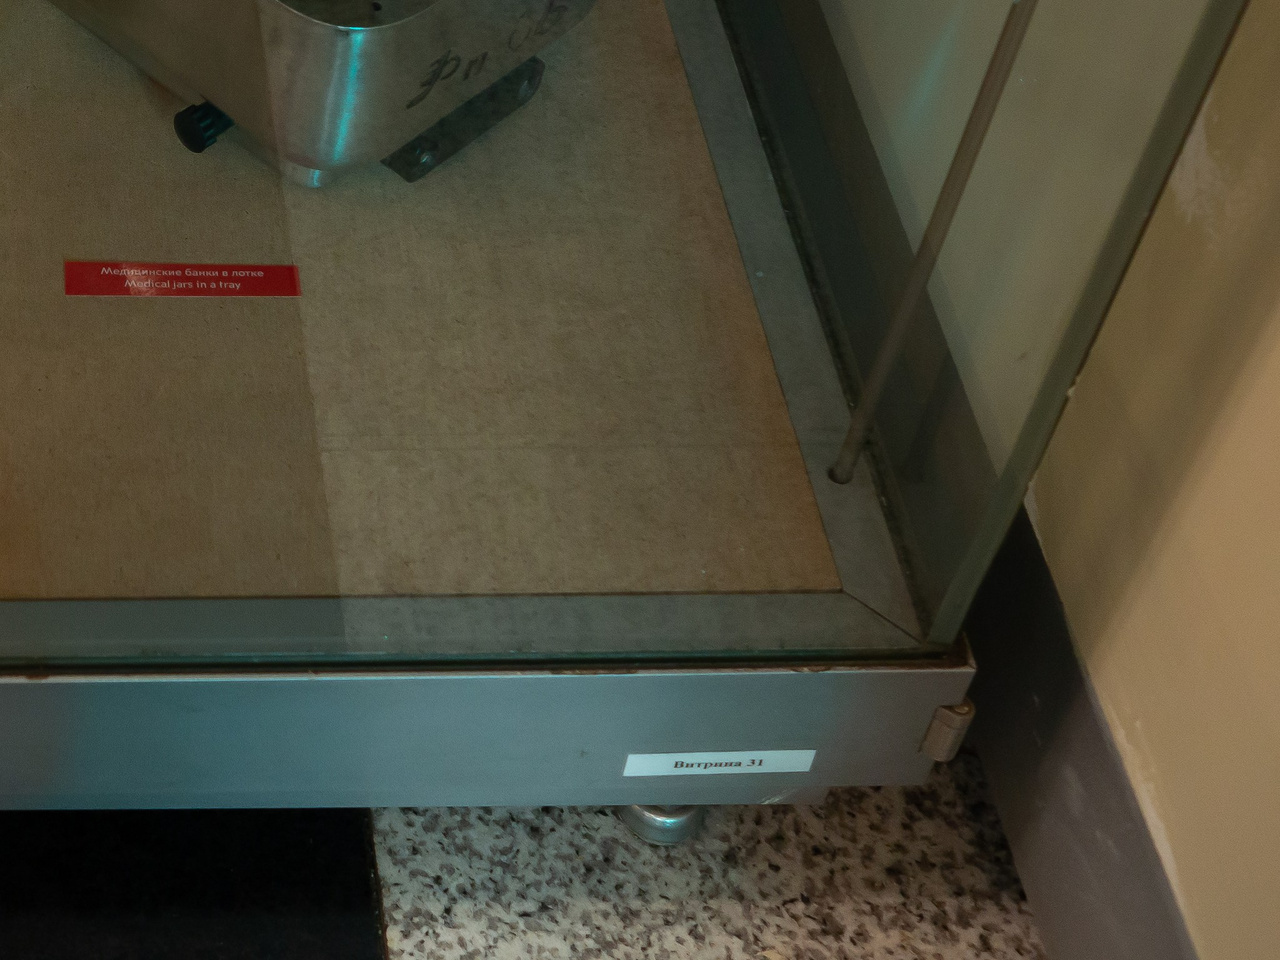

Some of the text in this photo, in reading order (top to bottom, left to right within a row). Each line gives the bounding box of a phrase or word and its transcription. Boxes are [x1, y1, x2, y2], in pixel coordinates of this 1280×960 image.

[100, 266, 182, 278] Медицинские
[184, 267, 219, 277] банки
[231, 270, 265, 278] лотке
[124, 279, 171, 289] Medical
[172, 279, 194, 290] jars
[196, 280, 207, 289] in
[219, 280, 241, 291] tray
[673, 758, 764, 770] Витрина 31
